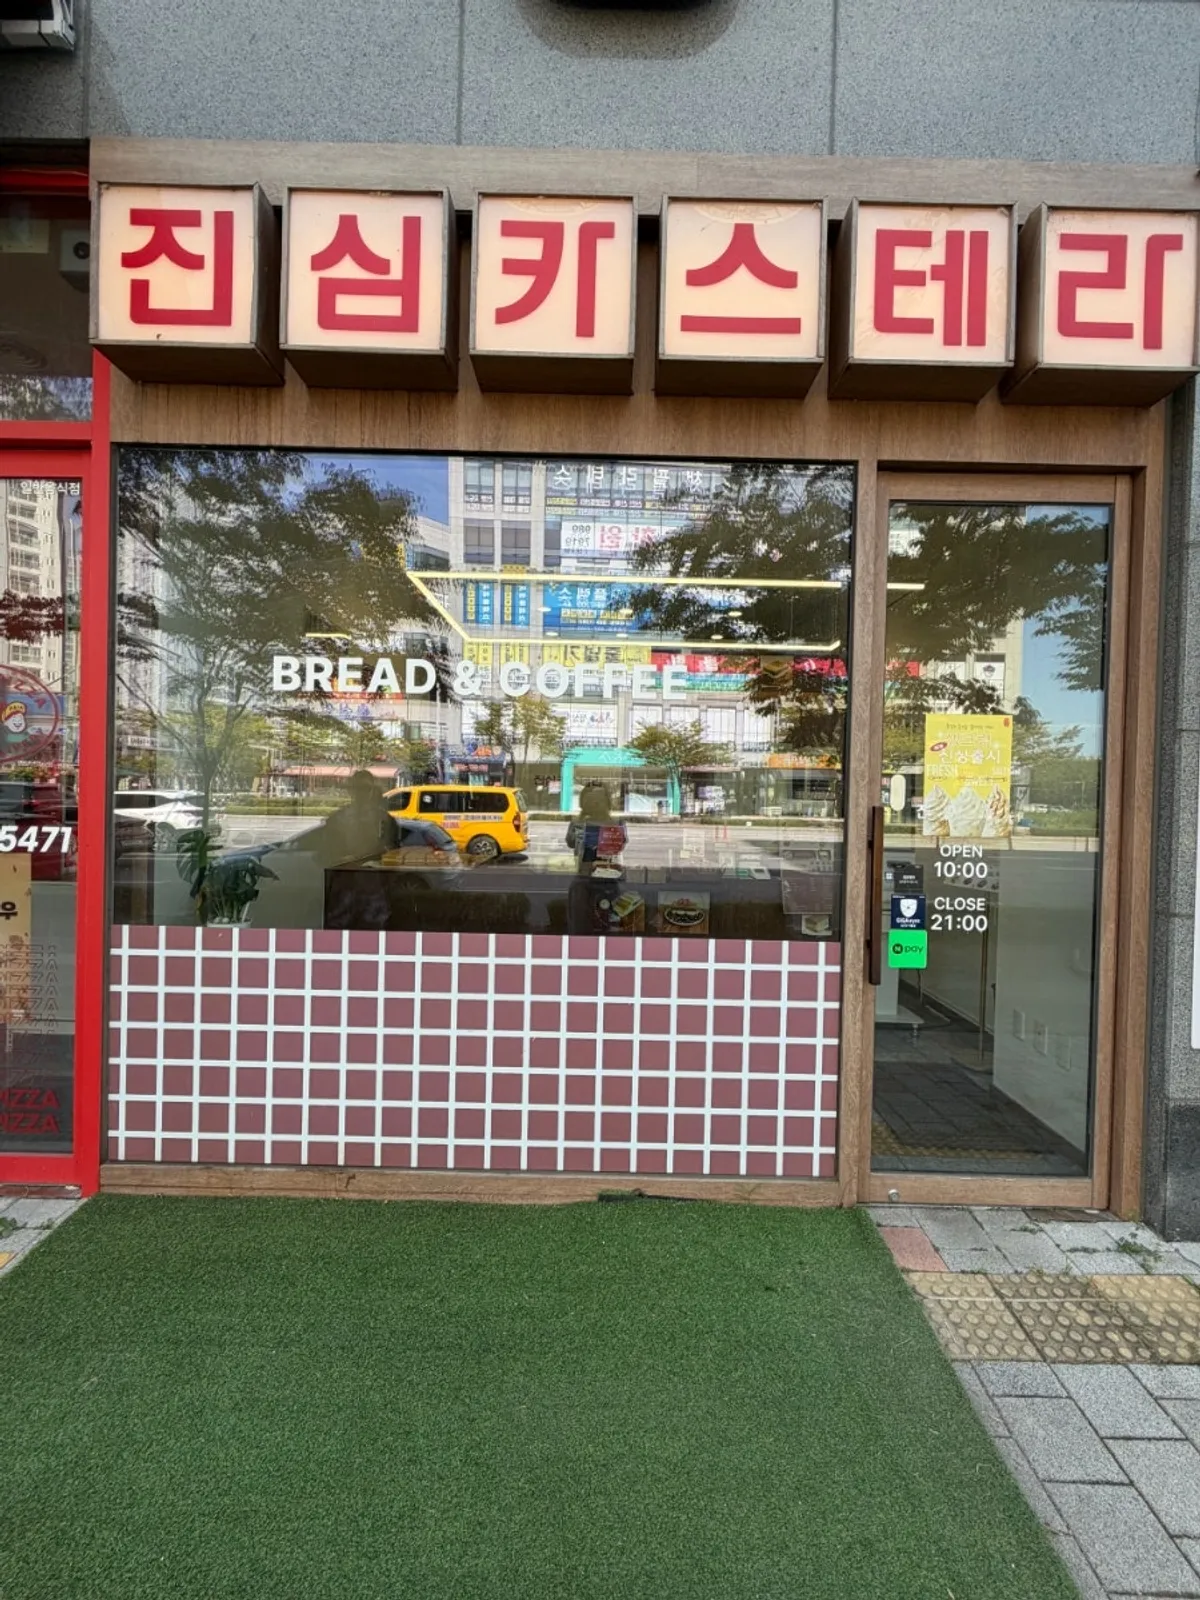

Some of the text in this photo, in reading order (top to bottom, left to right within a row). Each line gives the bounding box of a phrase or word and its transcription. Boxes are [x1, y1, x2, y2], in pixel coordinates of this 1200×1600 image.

[121, 208, 1183, 351] 진심카스테라
[272, 656, 437, 696] BREAD
[453, 660, 483, 697] &
[499, 663, 688, 700] COFFEE
[939, 844, 984, 859] OPEN
[933, 862, 988, 879] 10:00
[933, 896, 986, 911] CLOSE
[930, 914, 988, 932] 21:00
[904, 944, 924, 955] pay
